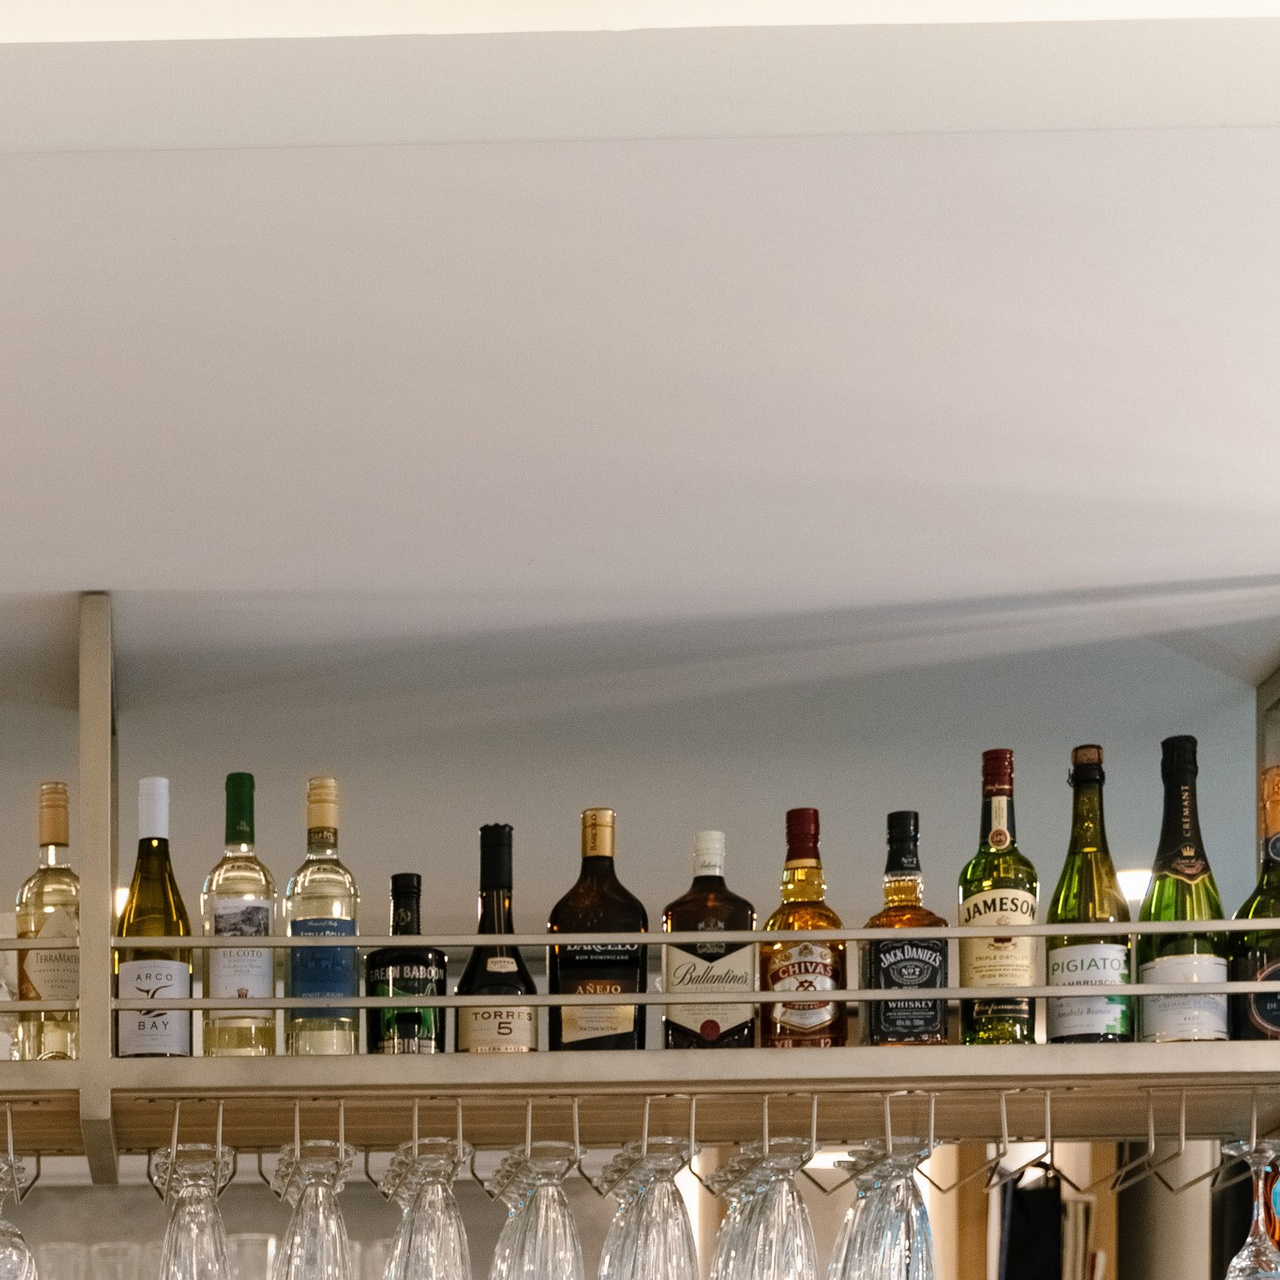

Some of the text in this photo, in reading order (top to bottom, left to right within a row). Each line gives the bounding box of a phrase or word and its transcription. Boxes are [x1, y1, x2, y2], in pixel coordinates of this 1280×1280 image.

[964, 896, 1036, 924] JAMESON
[222, 949, 263, 958] EL COTO
[879, 944, 942, 968] JACK DANIEL'S
[370, 965, 445, 981] GREEN BABOON
[778, 961, 833, 978] CHIVAS
[1051, 957, 1122, 977] PIGIATO
[135, 972, 174, 982] ARCO
[671, 962, 749, 986] Ballantine's
[575, 983, 622, 994] AÑEJO
[888, 1000, 934, 1009] WHISKEY
[471, 1010, 533, 1022] TORRES
[137, 1020, 170, 1031] BAY
[496, 1021, 513, 1036] 5
[819, 1038, 832, 1047] 12
